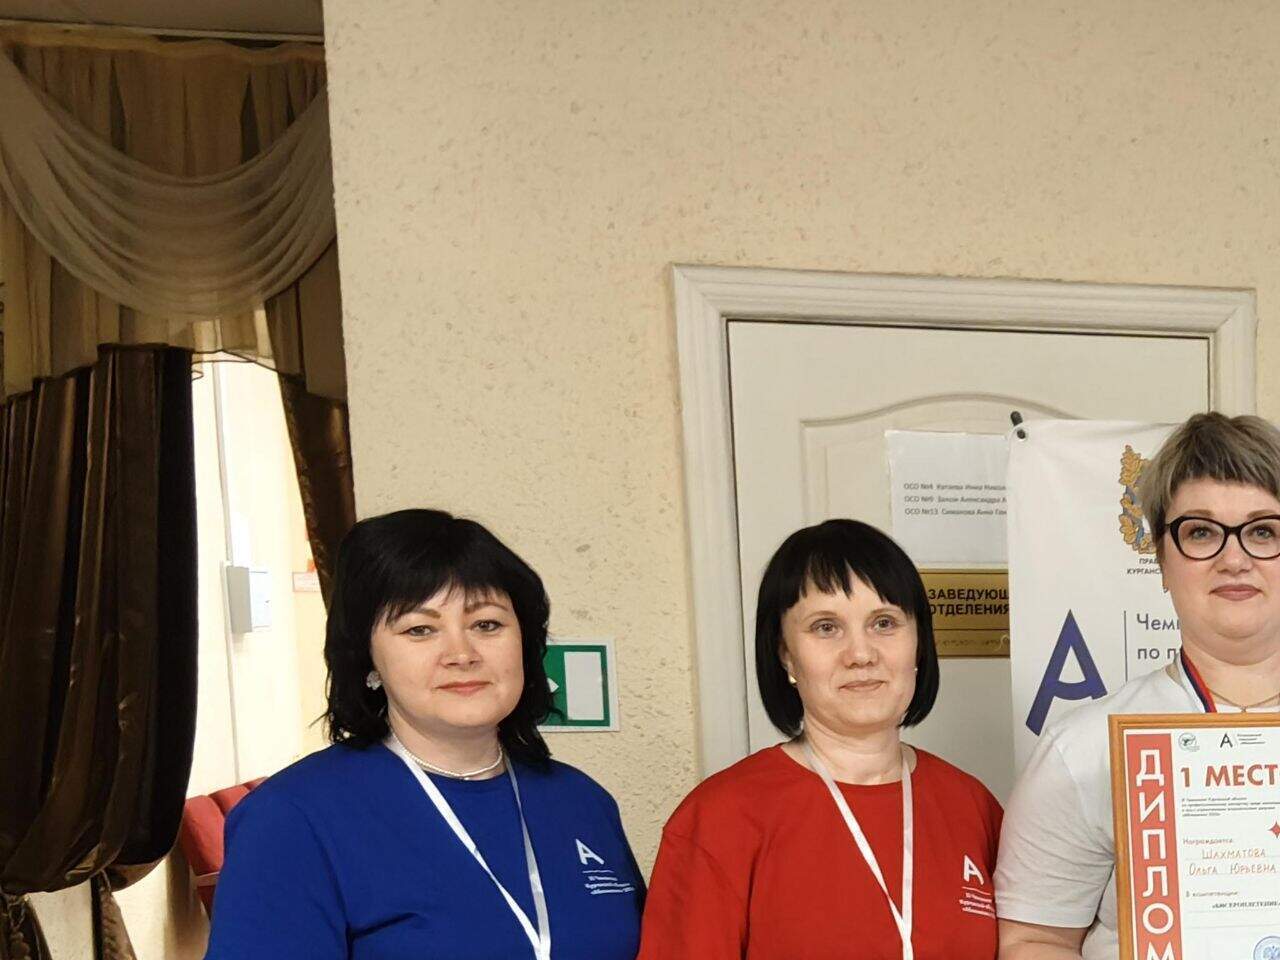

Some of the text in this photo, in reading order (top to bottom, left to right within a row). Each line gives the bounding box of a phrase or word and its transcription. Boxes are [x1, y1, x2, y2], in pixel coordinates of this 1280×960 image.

[928, 589, 1008, 601] ЗАВЕДУЮЩ
[1137, 613, 1179, 631] Чем
[1137, 648, 1160, 659] по
[1181, 767, 1190, 787] 1
